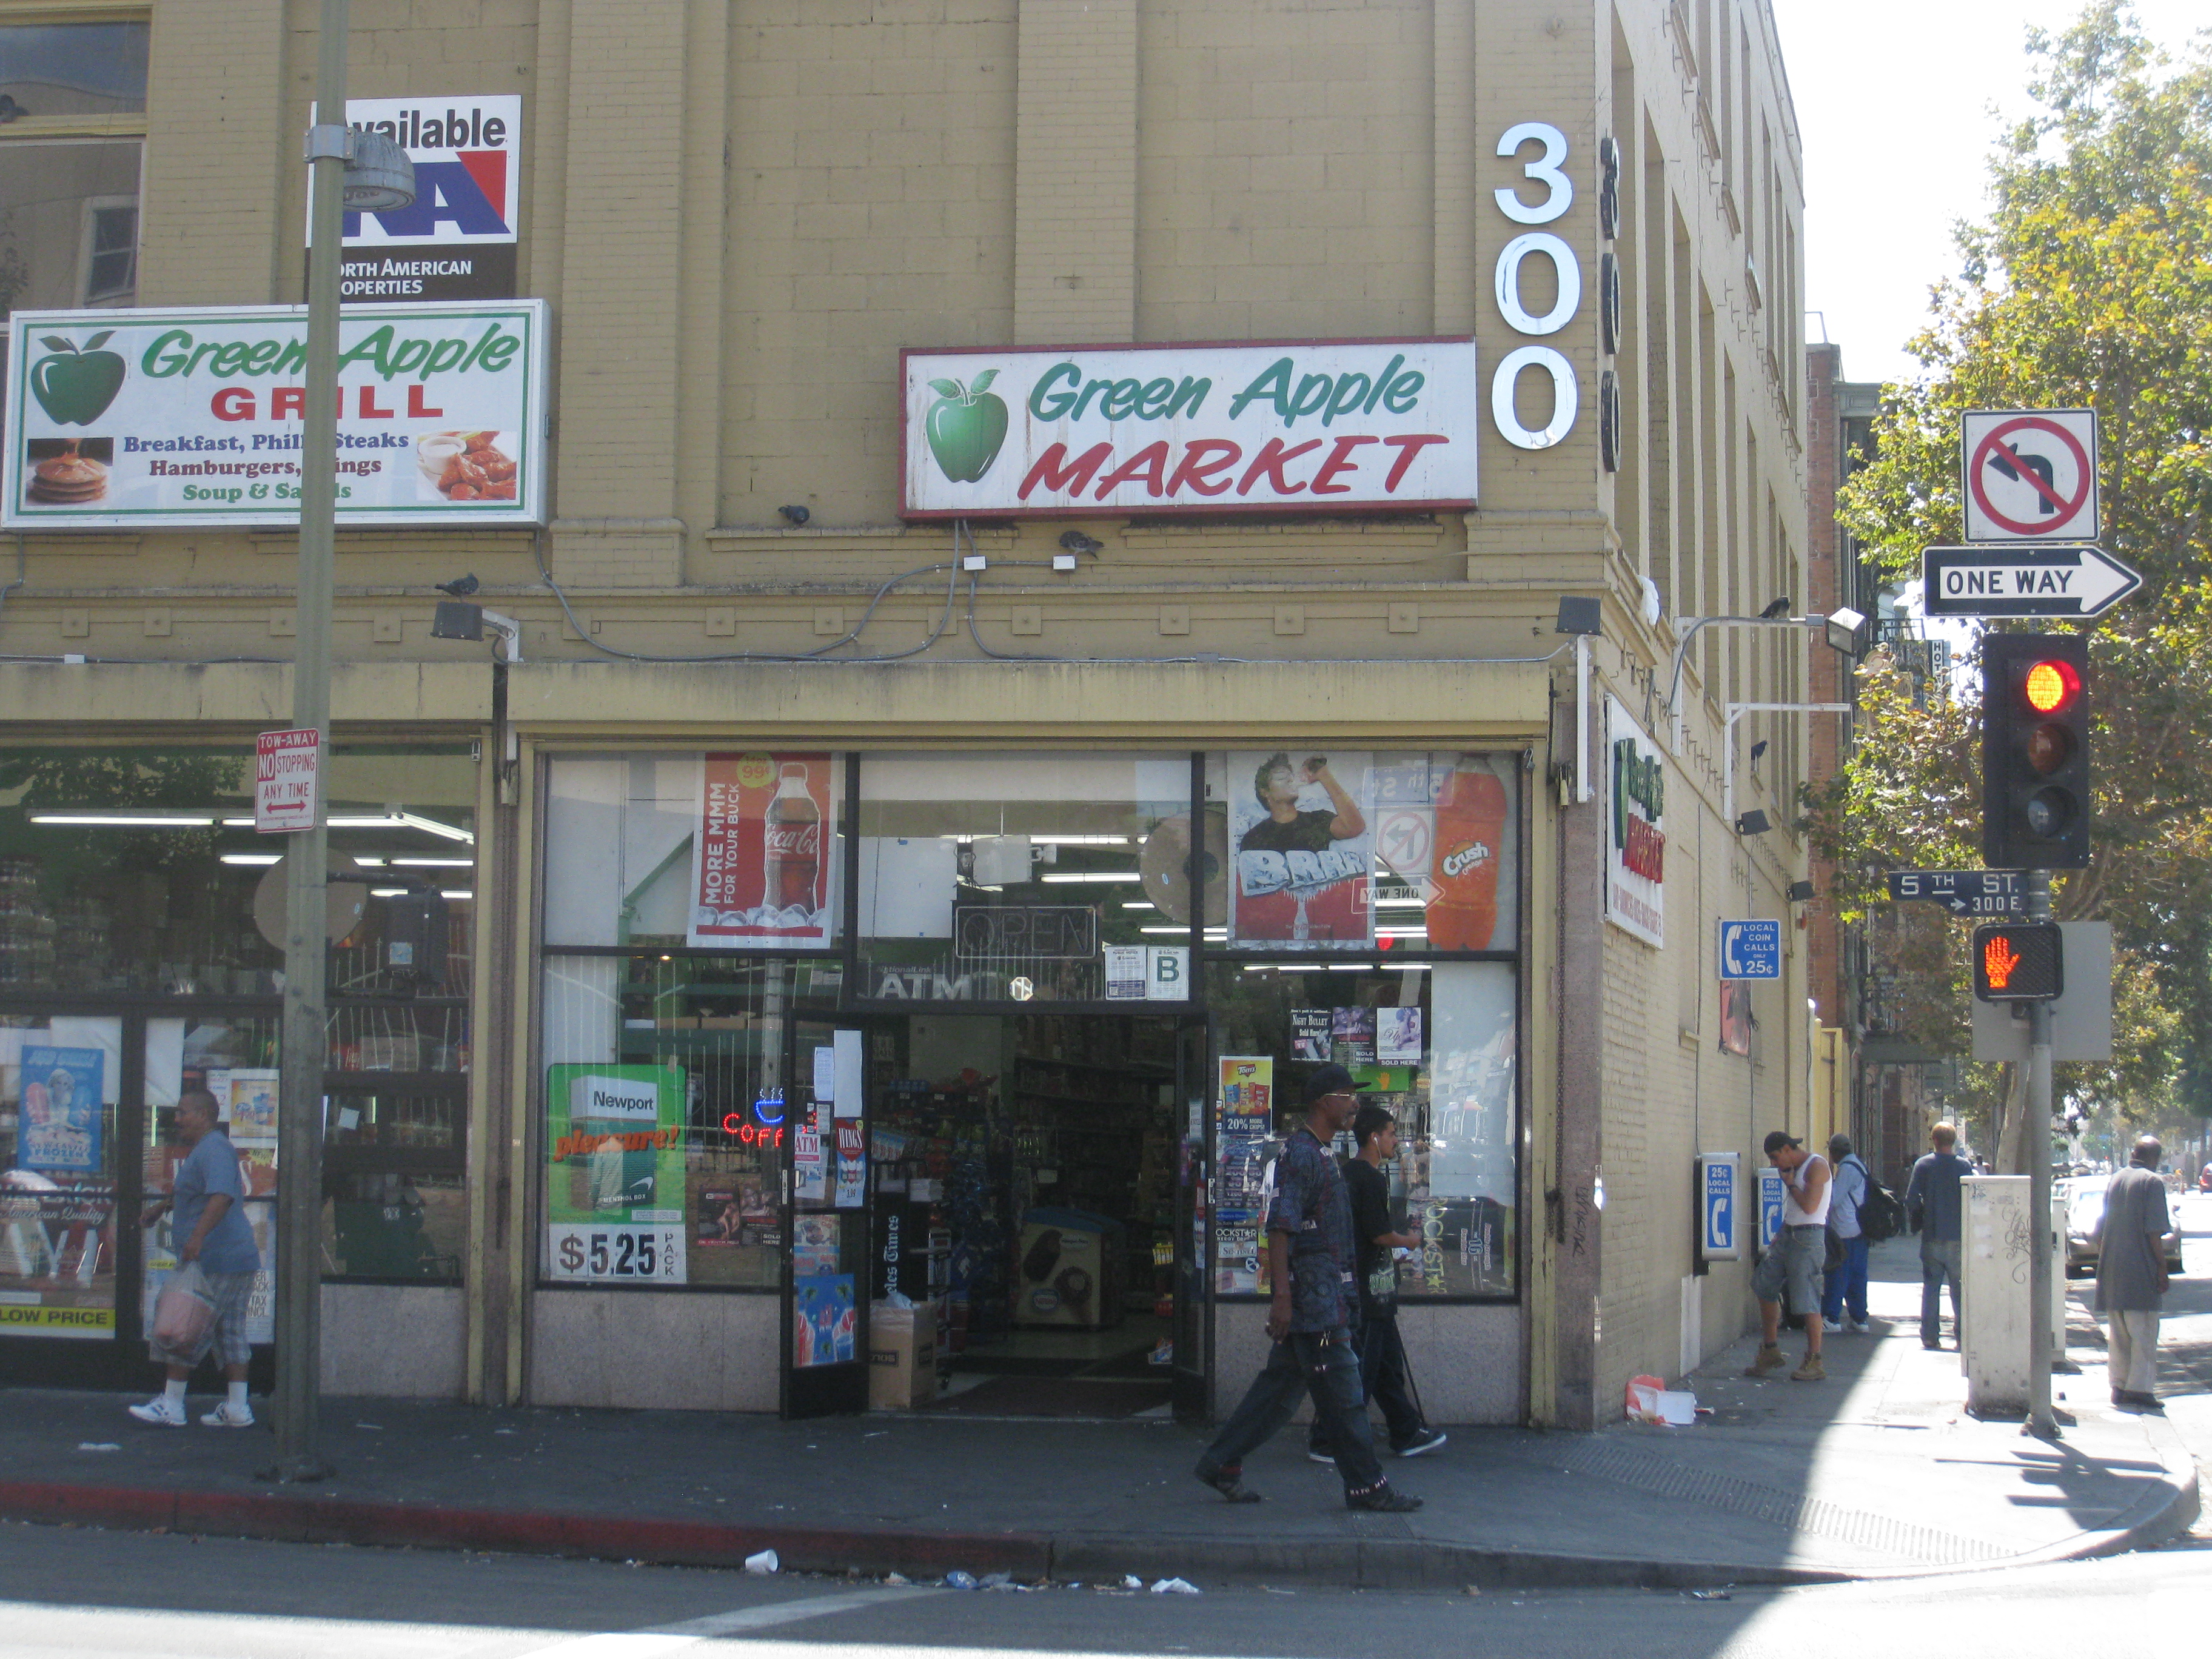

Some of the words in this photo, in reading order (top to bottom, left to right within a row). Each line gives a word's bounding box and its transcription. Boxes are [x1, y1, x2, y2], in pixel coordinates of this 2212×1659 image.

[352, 109, 506, 150] ailable
[341, 261, 377, 277] RTH
[381, 258, 472, 277] AMERICAN
[340, 279, 423, 296] OPERTIES
[141, 329, 308, 378] Green
[338, 323, 520, 381] Apple
[1029, 363, 1211, 421] Green
[1228, 354, 1424, 428] Apple
[124, 435, 245, 454] Breakfast,
[252, 434, 302, 451] Phil
[335, 432, 409, 449] Steaks
[149, 460, 302, 478] Hamburgers,
[335, 458, 382, 474] ings
[1017, 435, 1449, 501] MARKET
[183, 484, 243, 503] Soup
[249, 483, 270, 499] &
[1946, 571, 2003, 594] ONE
[2015, 569, 2074, 594] WAY
[260, 732, 317, 748] TOW-AWAY
[259, 754, 275, 778] NO
[277, 753, 315, 774] STOPPING
[264, 784, 283, 800] ANY
[288, 782, 309, 798] TIME
[709, 783, 726, 836] MMM
[727, 783, 740, 825] BUCK
[725, 829, 739, 870] YOUR
[1443, 841, 1489, 876] Crush
[705, 843, 724, 904] MORE
[1462, 859, 1483, 876] Orange
[724, 874, 737, 904] FOR
[1983, 873, 2018, 893] ST.
[1972, 896, 2005, 911] 300
[2010, 896, 2022, 911] E.
[964, 913, 1088, 952] OPEN
[1157, 956, 1179, 982] B
[1746, 960, 1774, 974] 25¢
[874, 973, 971, 999] ATM
[594, 1091, 654, 1111] Newport
[1227, 1118, 1248, 1130] 20%
[796, 1136, 818, 1148] ATM
[839, 1128, 862, 1148] WINGS
[61, 1205, 107, 1225] Quality
[883, 1215, 899, 1262] Times
[664, 1233, 674, 1275] PACK
[48, 1310, 108, 1324] PRICE
